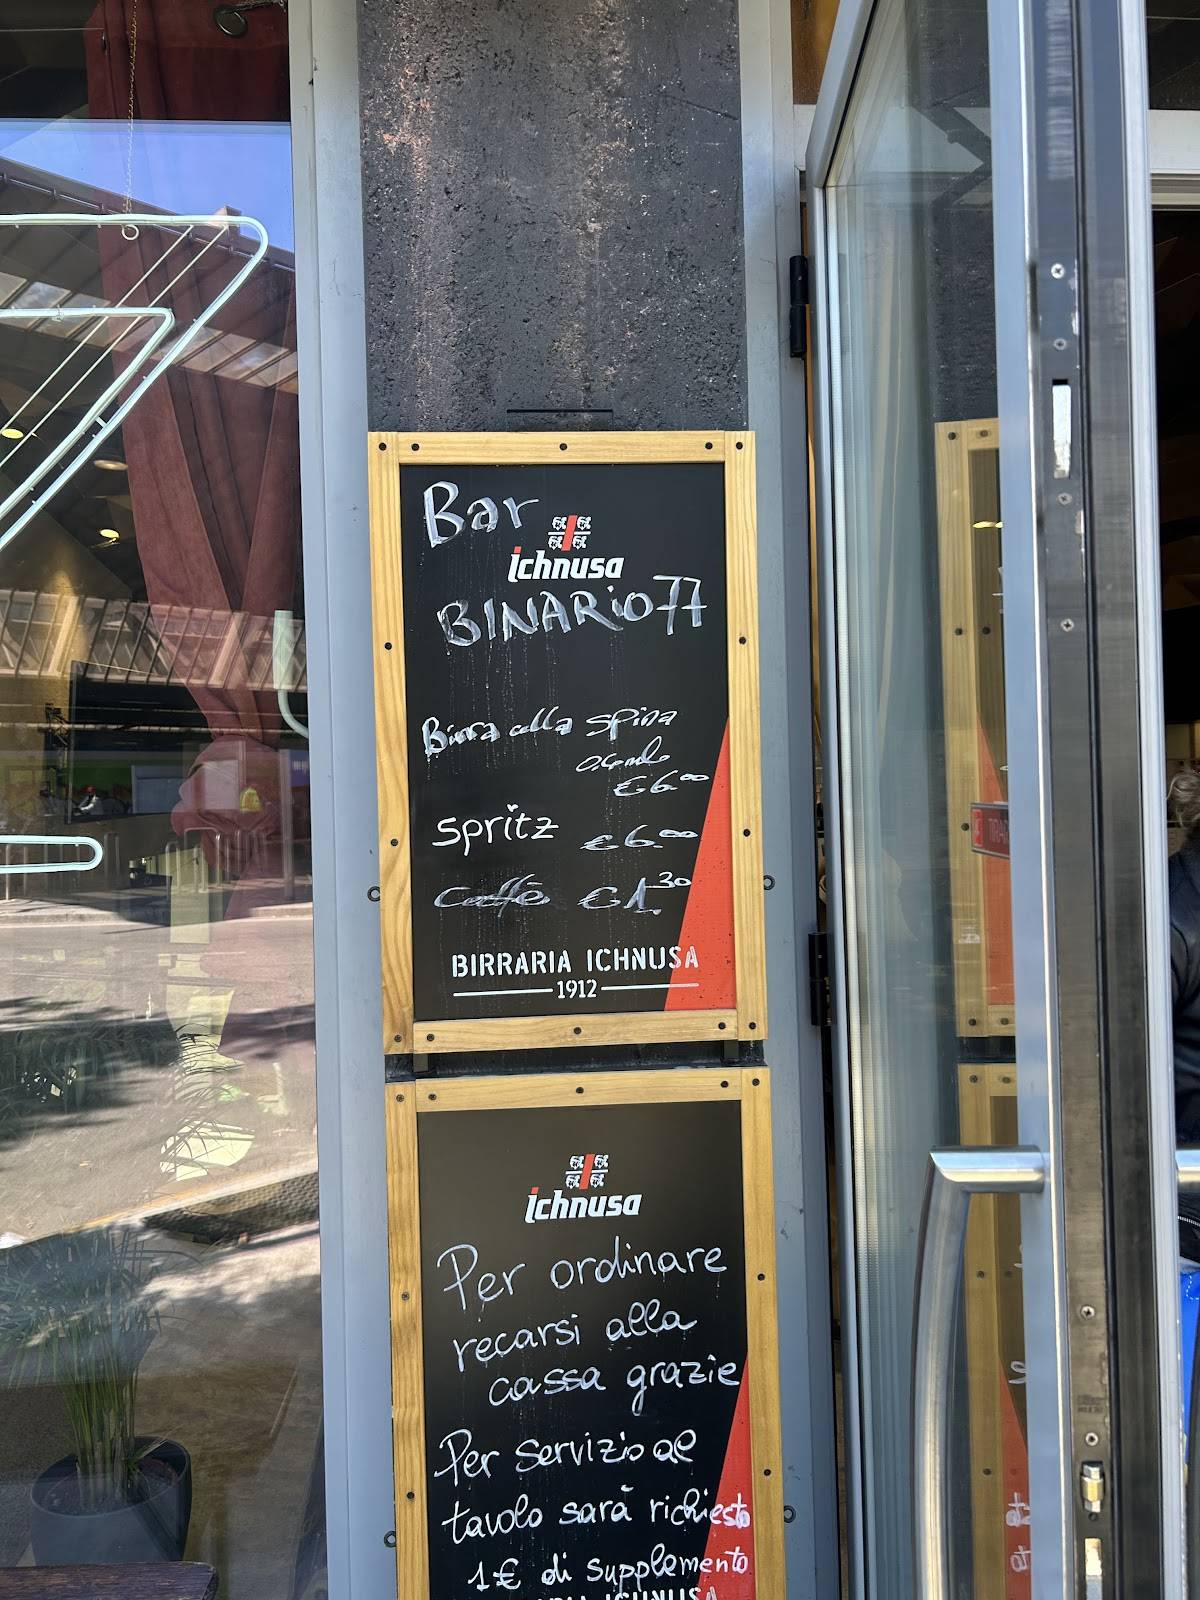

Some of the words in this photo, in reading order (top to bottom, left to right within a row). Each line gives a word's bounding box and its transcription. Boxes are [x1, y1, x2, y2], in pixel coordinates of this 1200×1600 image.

[423, 481, 539, 548] Bar
[508, 546, 625, 582] ichnusa
[586, 705, 678, 741] spina
[452, 950, 571, 977] BIRRARIA
[587, 946, 699, 972] ICHNUSA
[557, 979, 597, 999] 1912
[524, 1187, 642, 1223] ichnusa
[436, 1244, 526, 1311] Per
[550, 1236, 727, 1290] ordinare
[452, 1314, 581, 1373] recarsi
[605, 1299, 698, 1342] alla
[489, 1366, 606, 1406] cassa
[626, 1355, 740, 1417] grazie
[434, 1429, 500, 1487] Per
[515, 1432, 645, 1472] servizio
[442, 1494, 543, 1545] tavolo
[650, 1488, 751, 1529] richiesto
[467, 1558, 522, 1592] 1€
[541, 1552, 572, 1586] di
